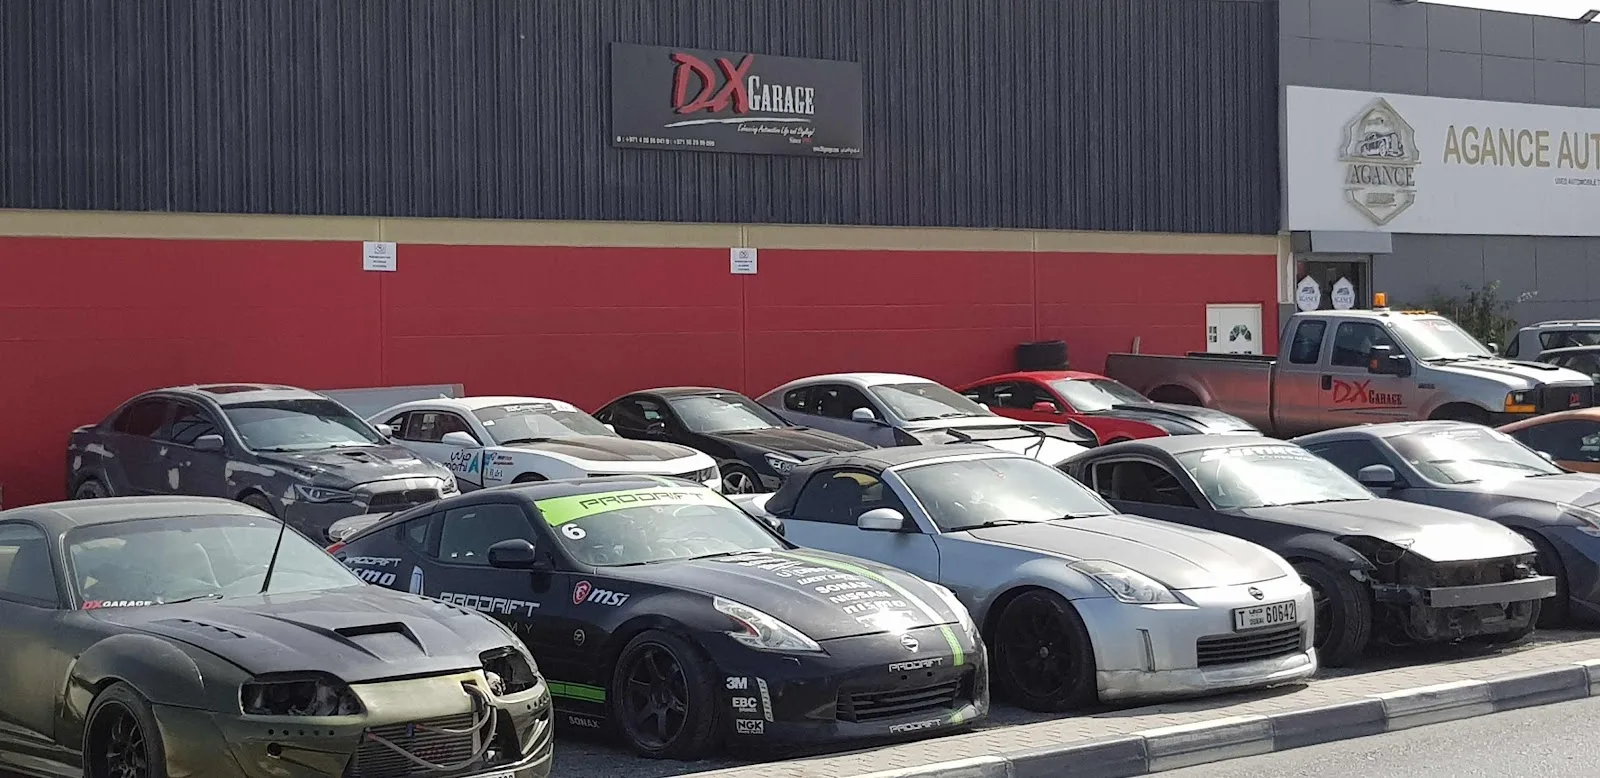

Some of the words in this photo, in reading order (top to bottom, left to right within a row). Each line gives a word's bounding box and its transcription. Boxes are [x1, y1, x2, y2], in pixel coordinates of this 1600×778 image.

[671, 53, 754, 114] DX
[1443, 125, 1550, 167] AGANCE
[1347, 164, 1415, 187] AGANCE
[1332, 379, 1371, 403] DX
[579, 492, 705, 510] PRODRIFT
[561, 523, 587, 540] 6
[440, 592, 541, 618] PRODRIFT
[829, 590, 893, 603] NISSAN
[1238, 611, 1245, 626] T
[1265, 602, 1295, 623] 60642
[888, 657, 943, 672] PRODRIFT
[726, 676, 748, 689] 3M
[732, 696, 757, 708] EBC
[737, 720, 763, 730] NGK
[888, 719, 941, 733] PRODRIFT
